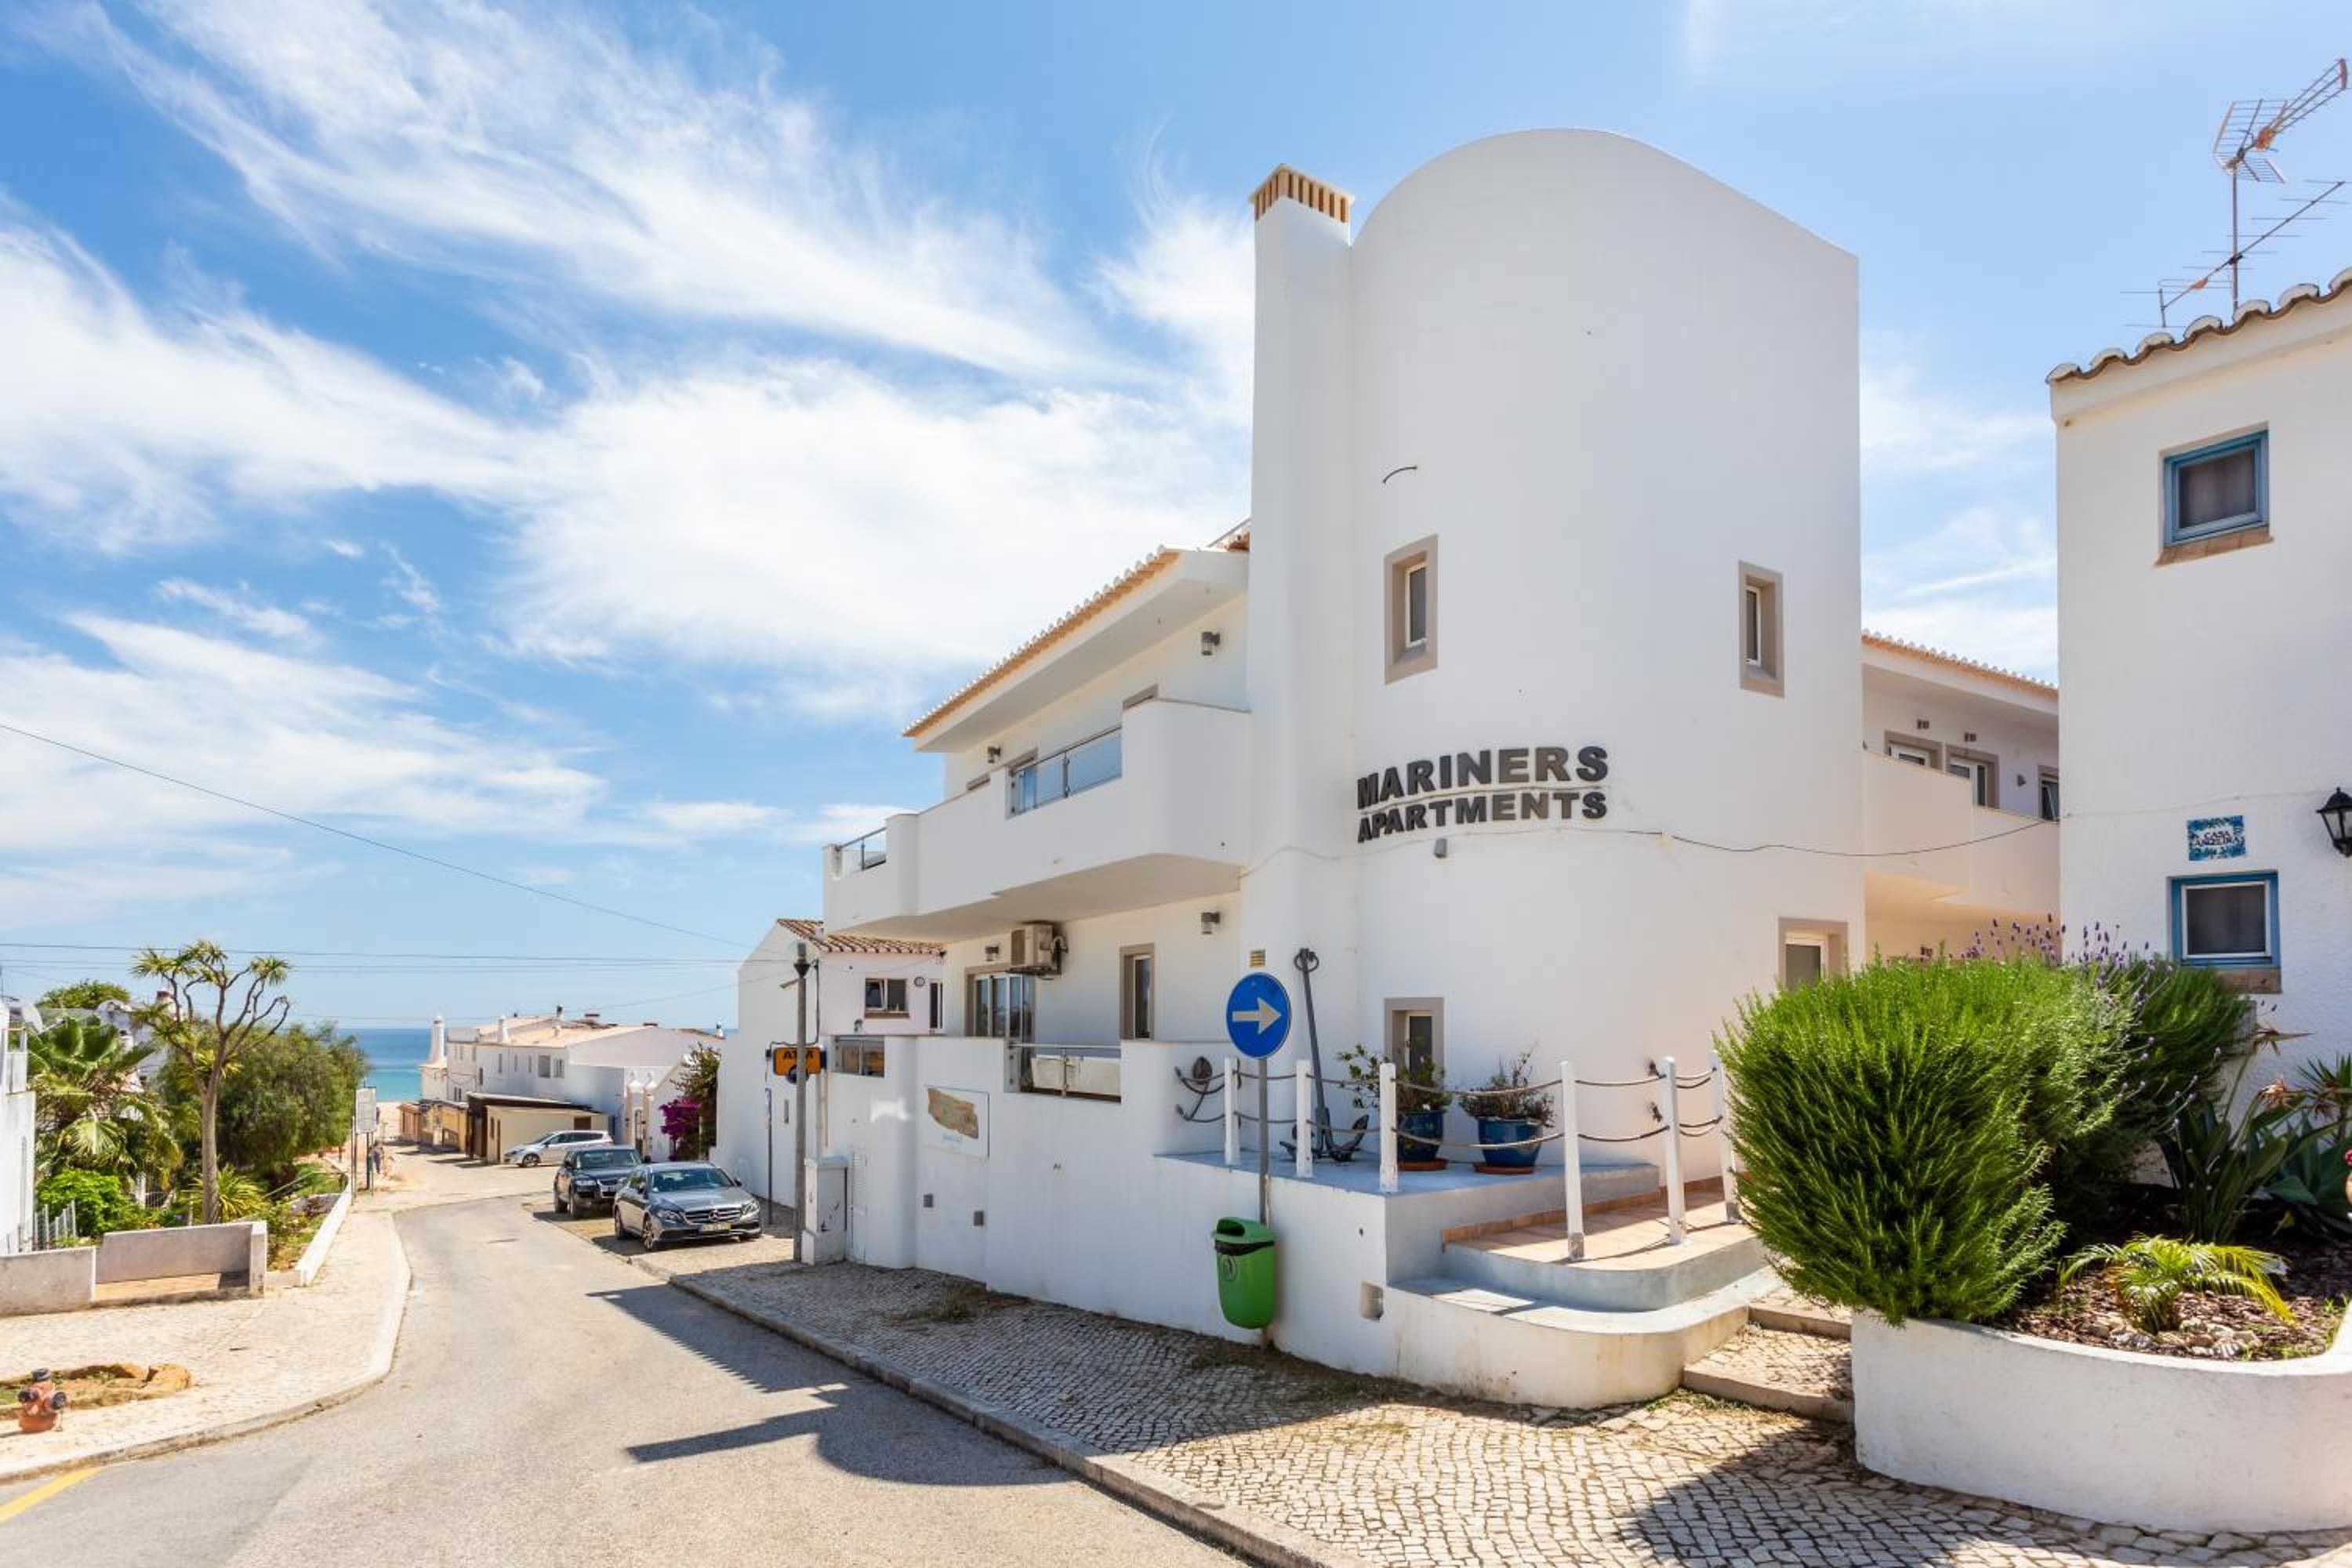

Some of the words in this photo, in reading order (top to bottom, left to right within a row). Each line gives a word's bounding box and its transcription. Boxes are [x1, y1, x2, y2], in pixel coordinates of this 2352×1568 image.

[1357, 746, 1608, 809] MARINERS
[1357, 792, 1606, 843] APARTMENTS
[2204, 830, 2230, 839] CASA
